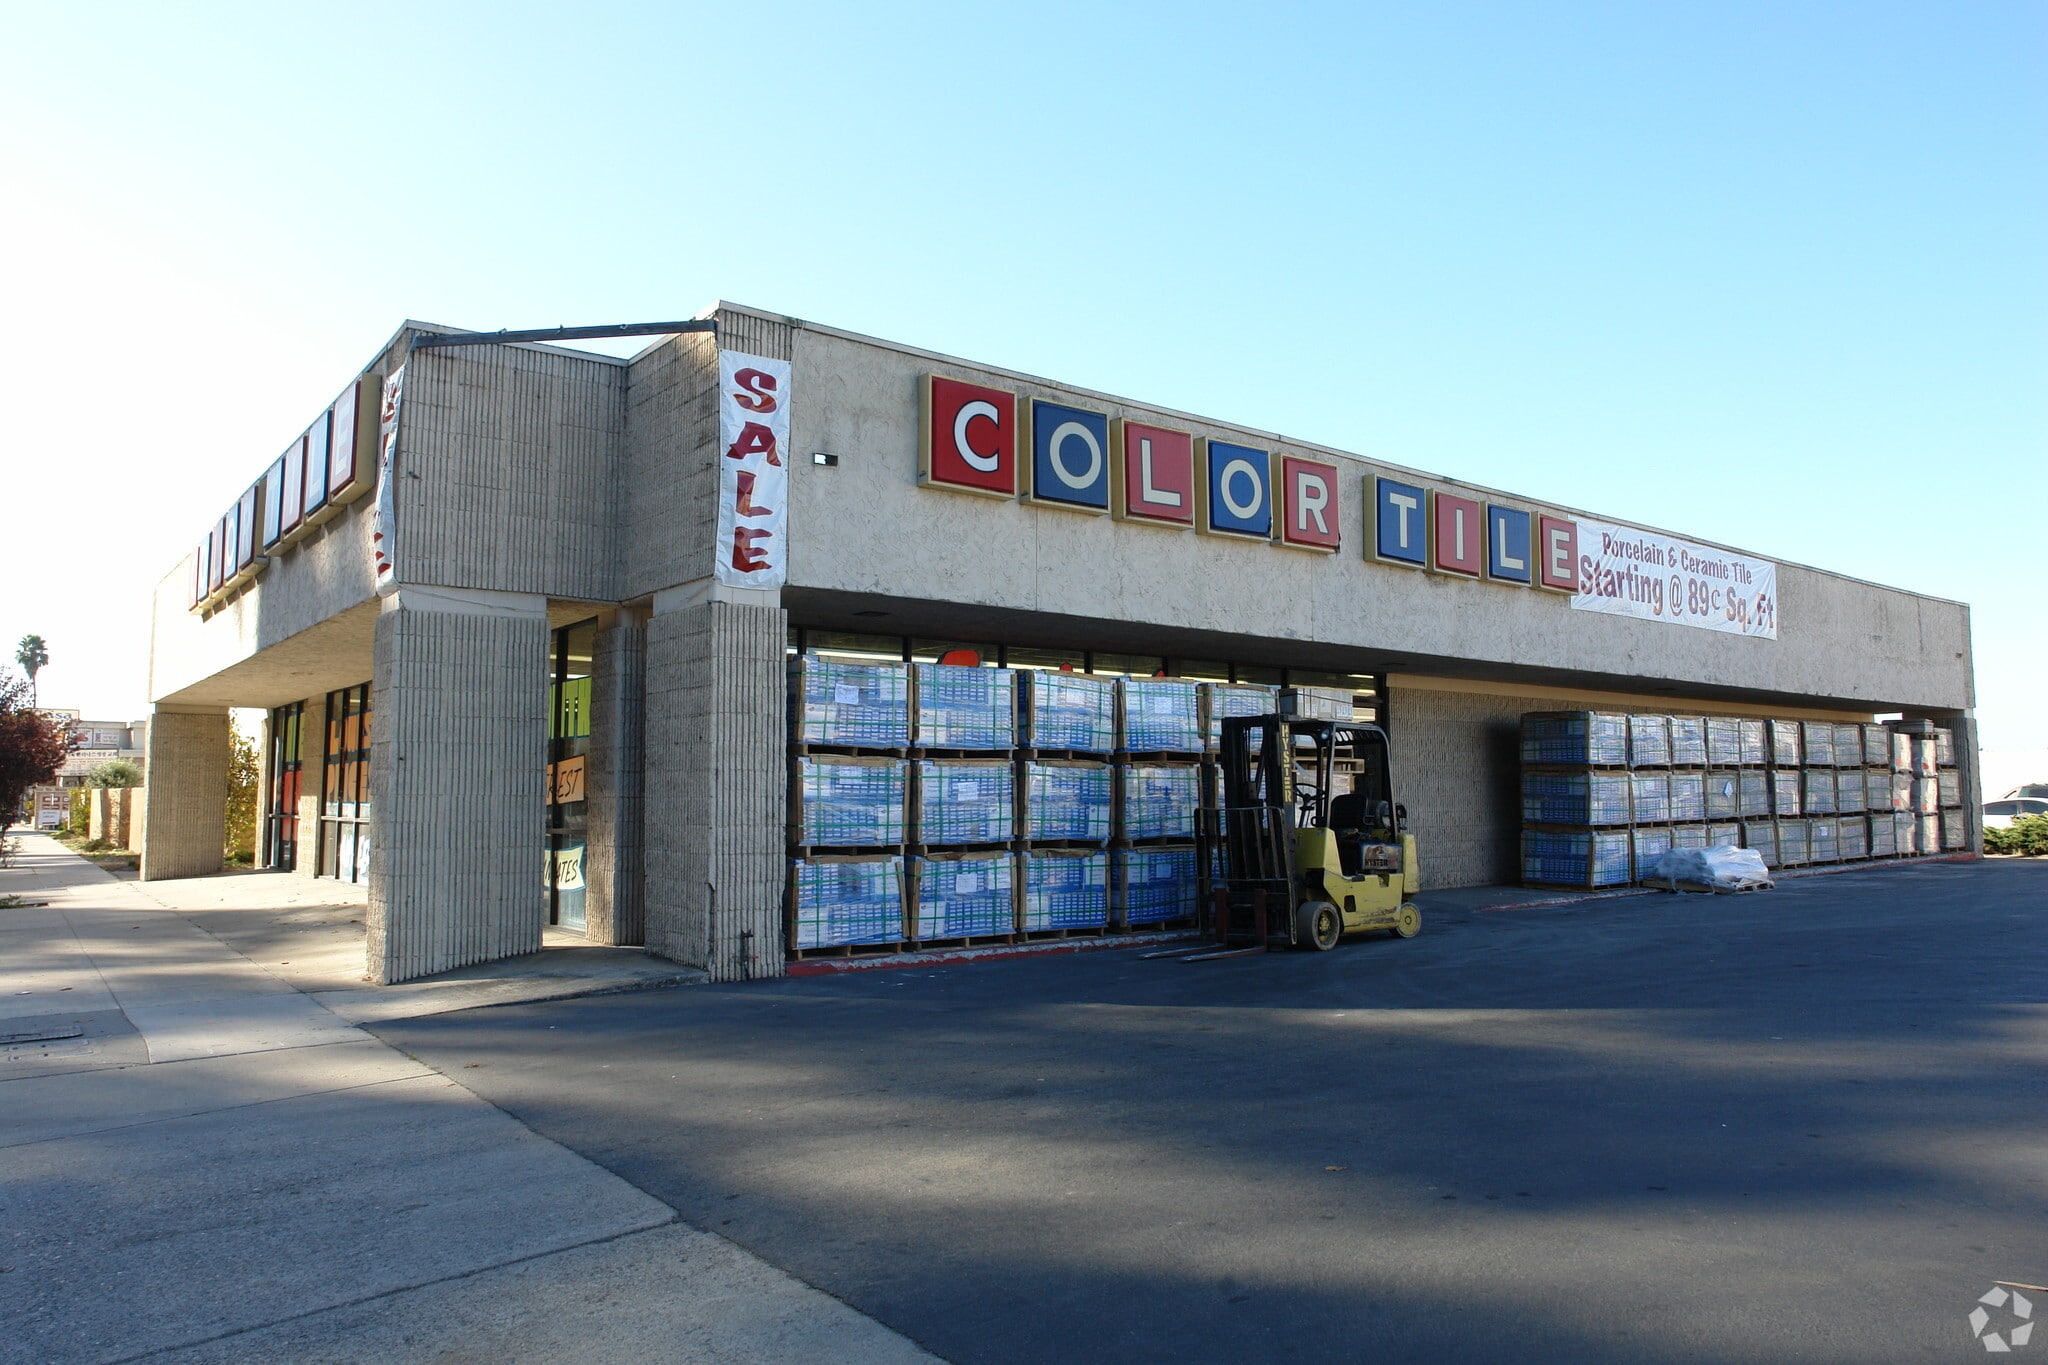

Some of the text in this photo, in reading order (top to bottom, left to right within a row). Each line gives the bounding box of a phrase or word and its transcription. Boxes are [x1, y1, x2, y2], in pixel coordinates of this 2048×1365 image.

[726, 367, 782, 573] SALE
[954, 399, 1572, 580] COLOR TILE
[1580, 554, 1663, 615] Starting
[1669, 574, 1683, 617] @
[1726, 586, 1752, 632] Sq.
[1602, 532, 1752, 585] Porcelain & Ceramic Tile
[1281, 724, 1292, 802] HYSTER
